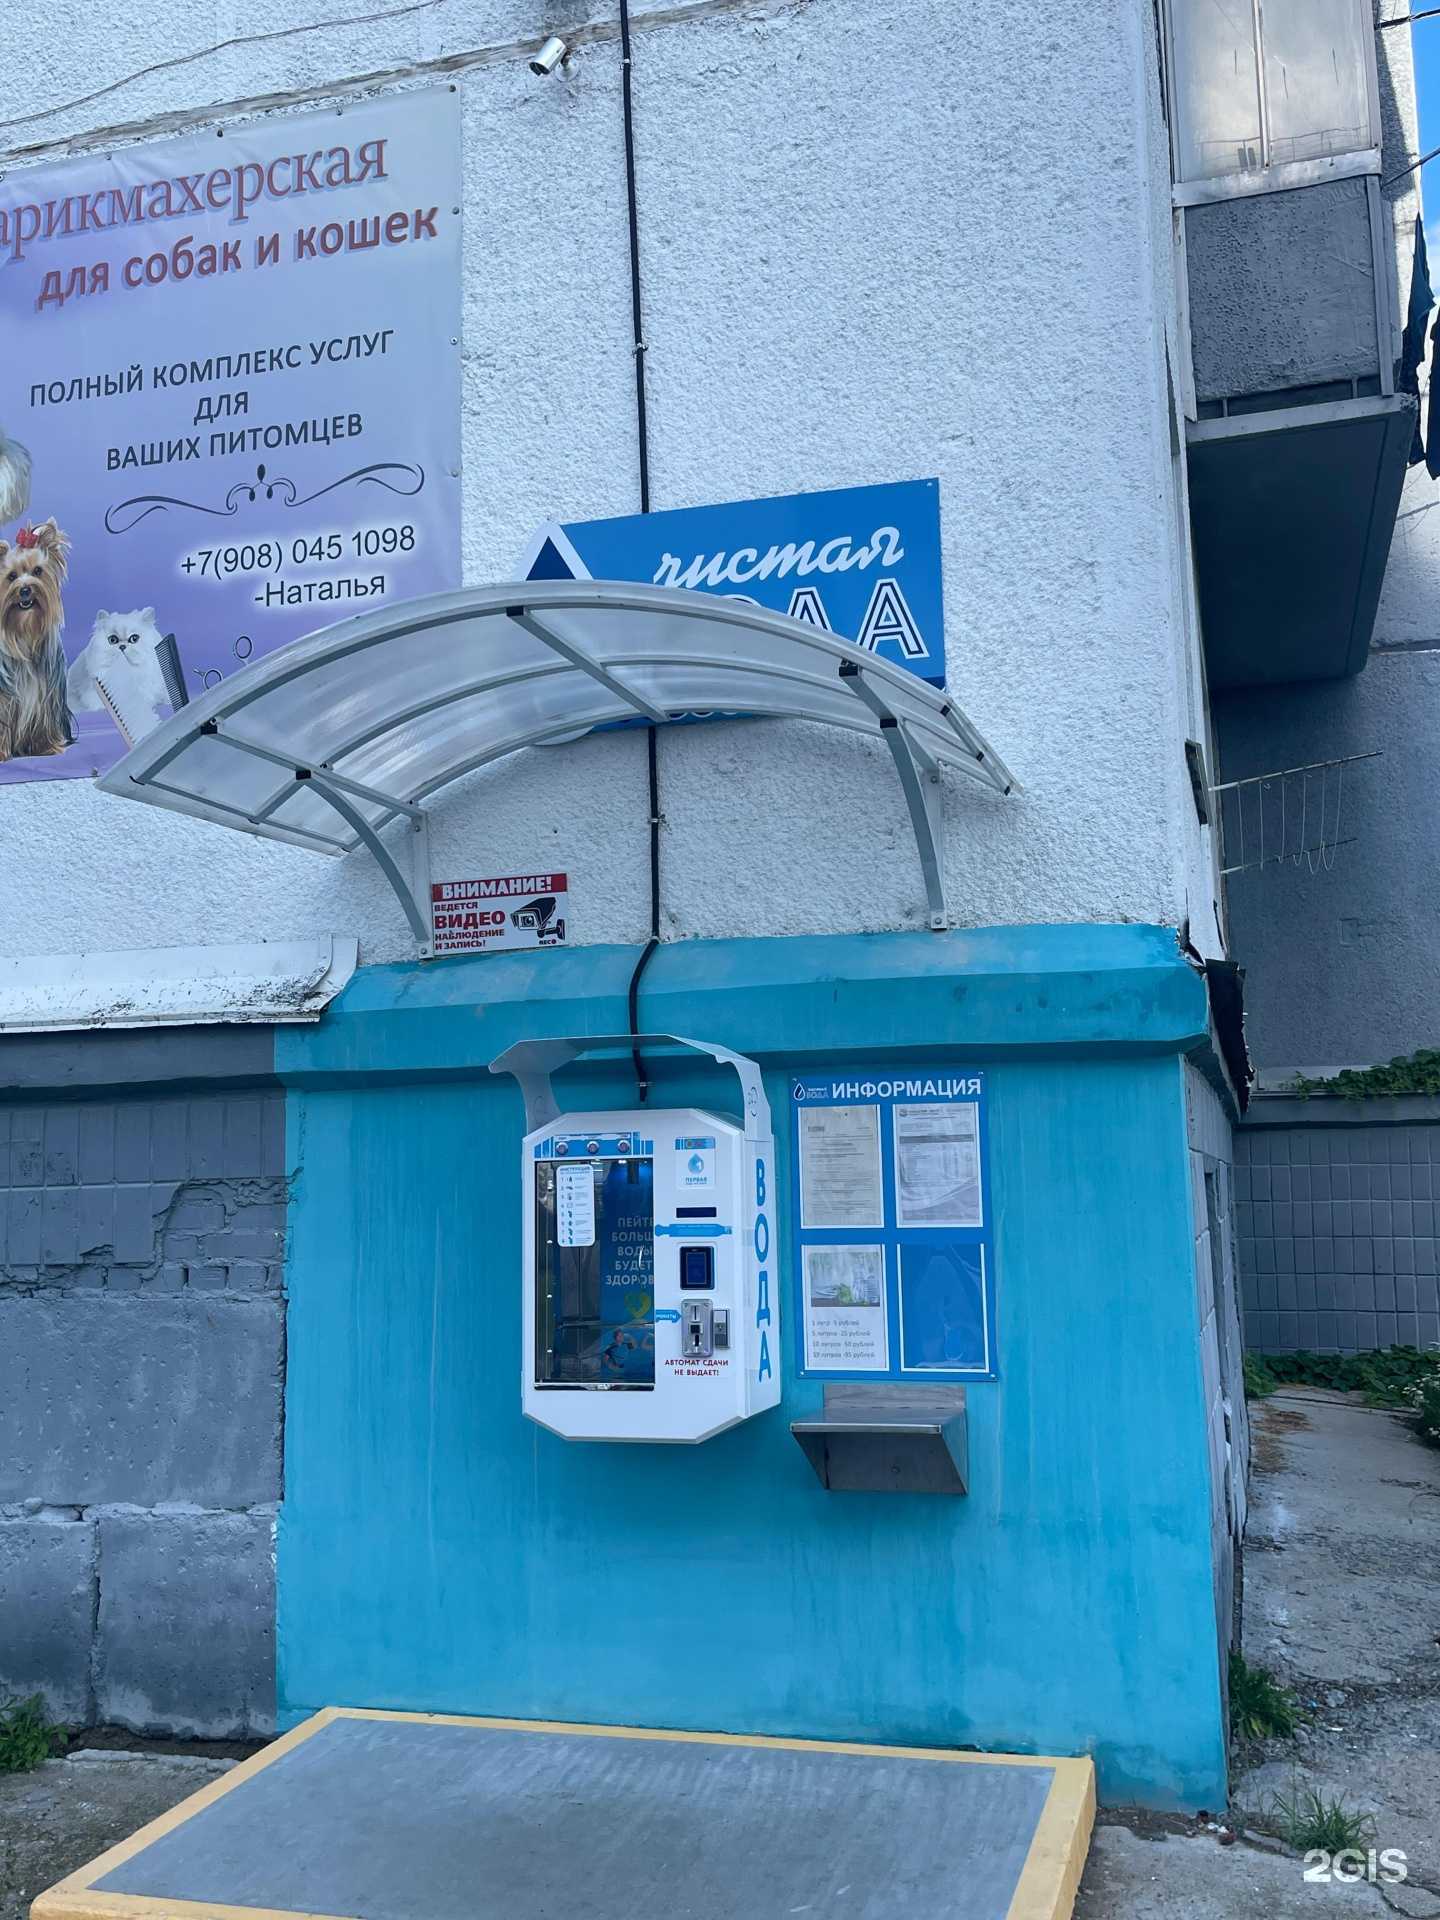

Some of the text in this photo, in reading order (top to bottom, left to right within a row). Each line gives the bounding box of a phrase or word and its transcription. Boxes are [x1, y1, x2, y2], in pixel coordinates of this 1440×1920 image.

[38, 206, 440, 310] для собак и кошек
[30, 329, 395, 407] ПОЛНЫЙ КОМПЛЕКС УСЛУГ
[194, 391, 249, 426] ДЛЯ
[107, 413, 364, 471] ВАШИХ ПИТОМЦЕВ
[181, 525, 416, 581] +7(908) 045 1098
[254, 575, 386, 608] -Наталья
[442, 876, 552, 900] ВНИМАНИЕ!
[434, 901, 479, 913] ВЕДЕТСЯ
[434, 911, 506, 930] ВИДЕО
[435, 929, 505, 941] НАБЛЮДЕНИЕ
[444, 940, 486, 950] ЗАПИСЬ!
[832, 1078, 982, 1099] ИНФОРМАЦИЯ
[755, 1158, 772, 1383] ВОДА
[686, 1369, 720, 1377] ВЫДАЕТ!
[702, 1359, 729, 1367] СДАЧИ
